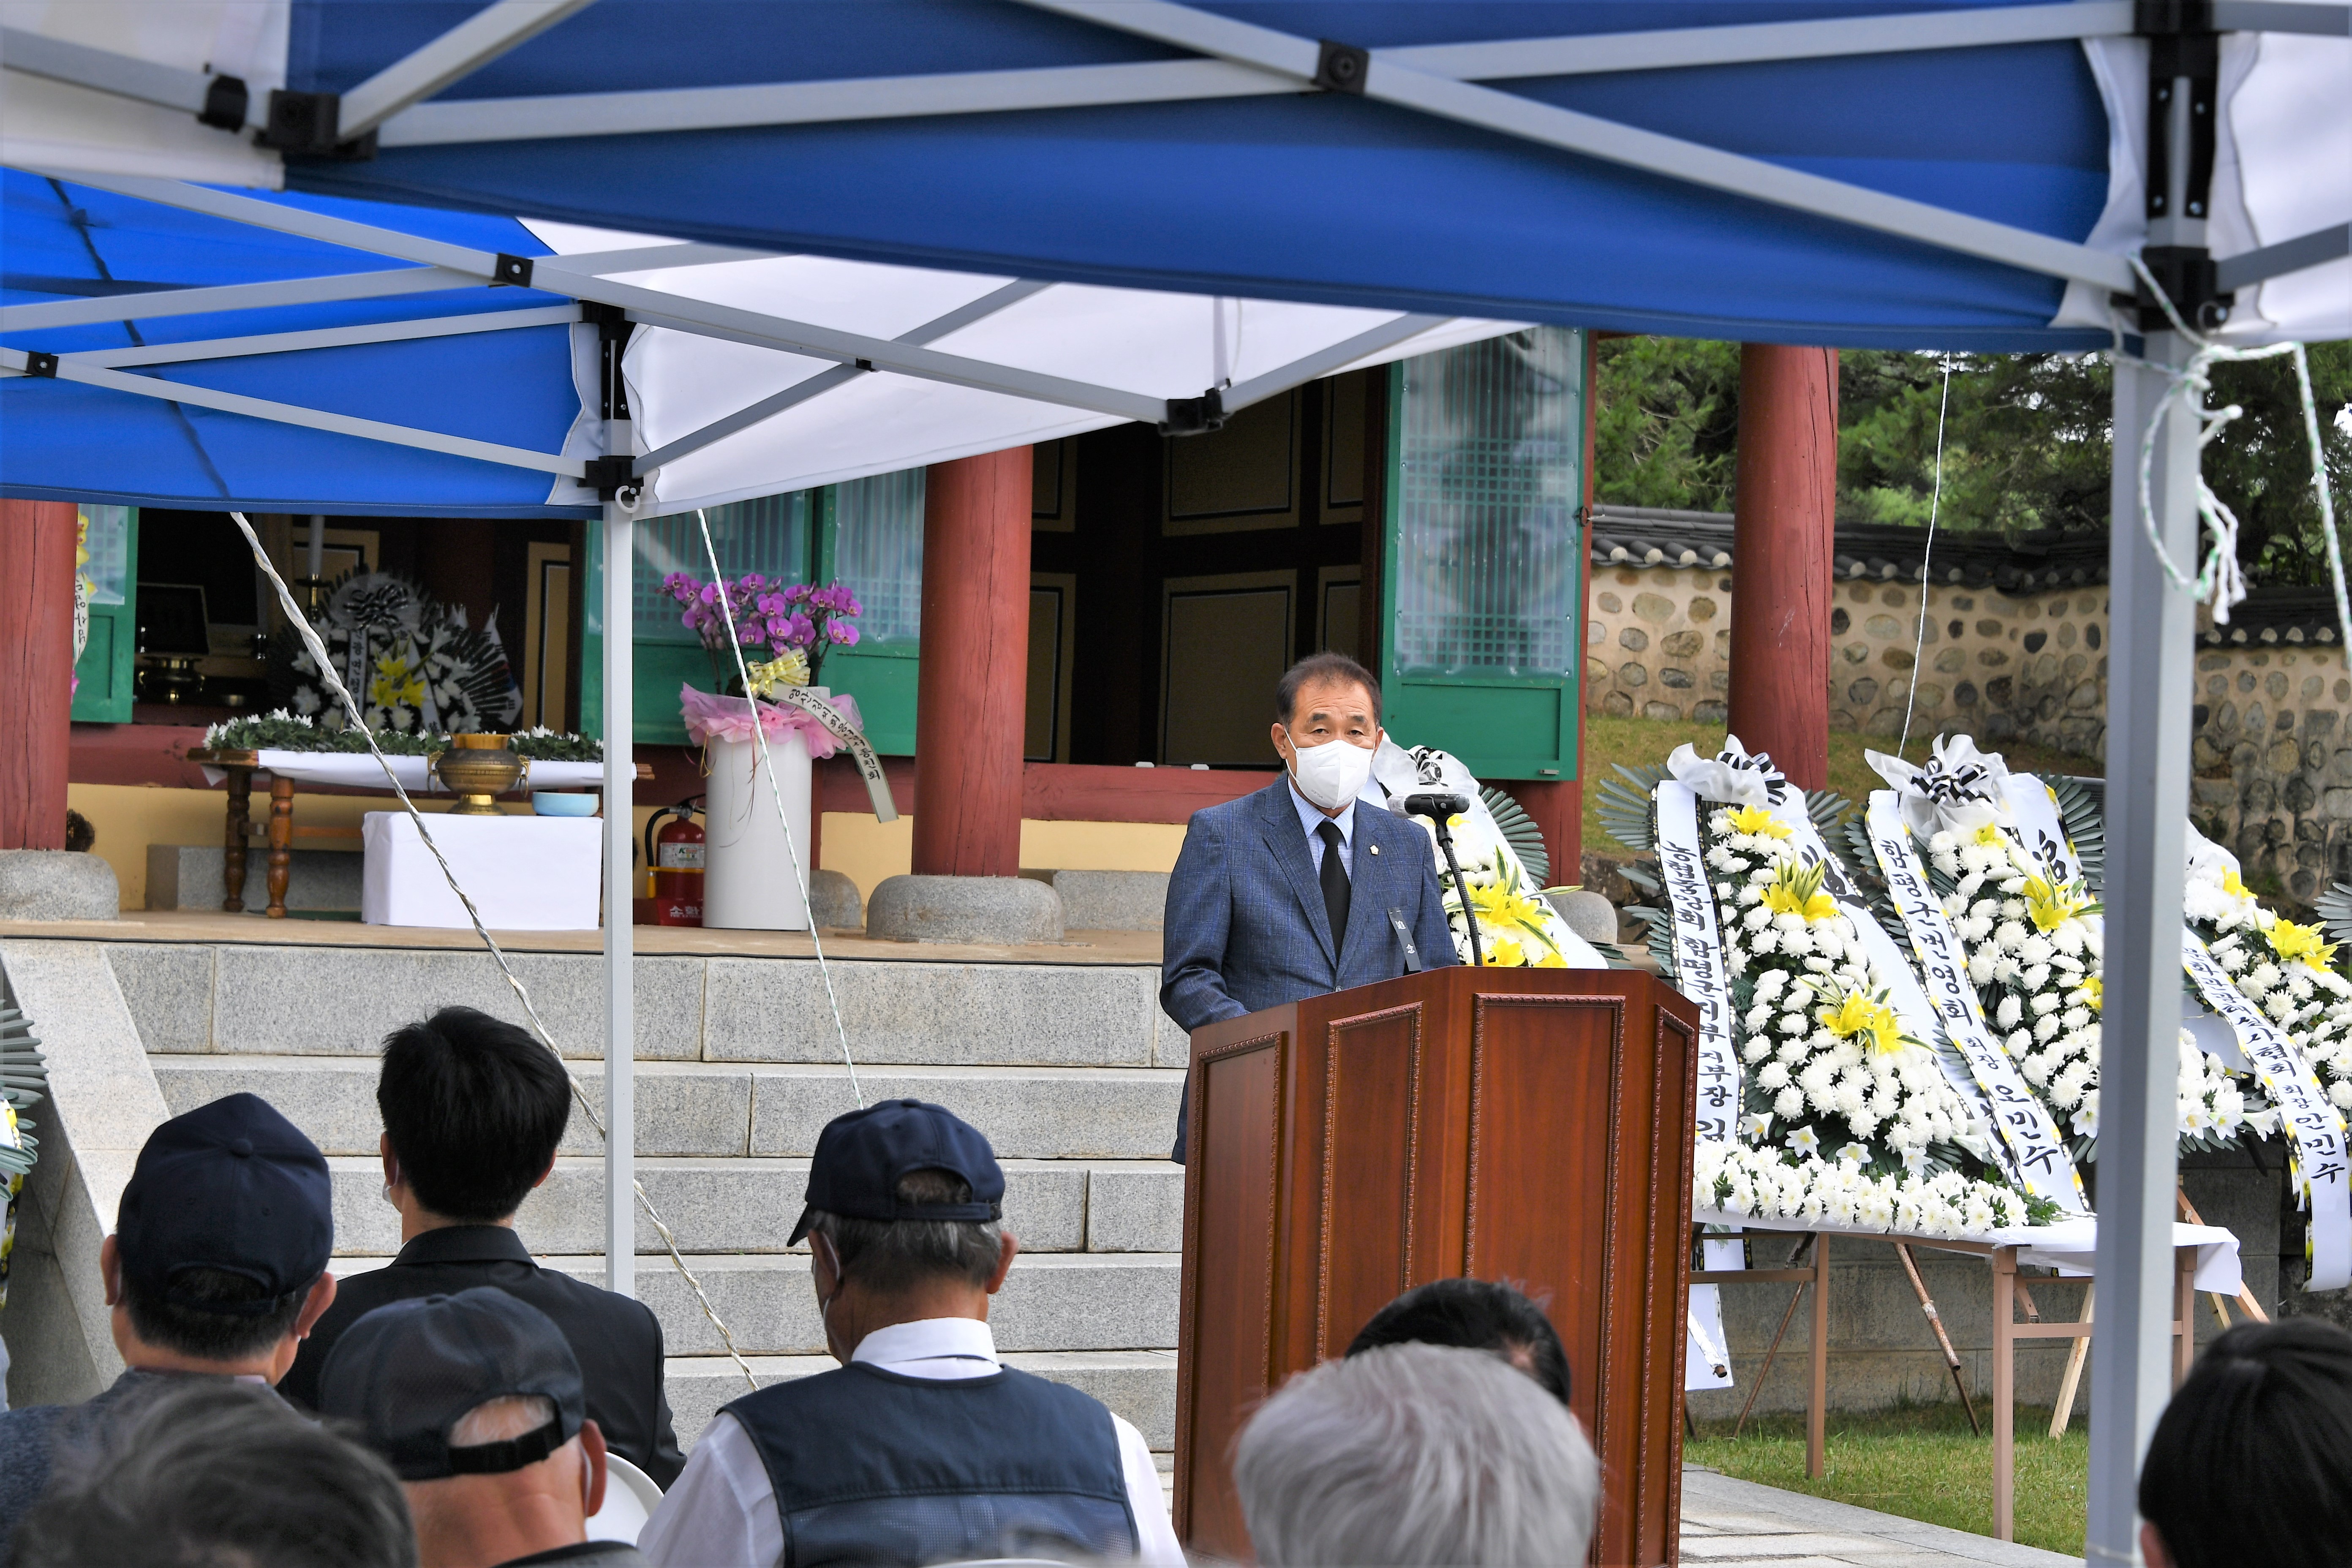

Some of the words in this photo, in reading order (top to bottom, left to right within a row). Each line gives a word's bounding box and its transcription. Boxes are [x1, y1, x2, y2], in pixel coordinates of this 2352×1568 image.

[670, 905, 703, 915] 소화
[1661, 840, 1711, 931] 농협중앙회
[1679, 934, 1726, 1043] 함평군지부
[1880, 838, 1973, 1027] 함평군번영회
[1964, 1036, 2001, 1070] 회장
[1995, 1084, 2058, 1175] 오민수
[1698, 1050, 1733, 1108] 지부장
[2282, 1084, 2313, 1109] 회장
[2295, 1113, 2345, 1184] 안민수
